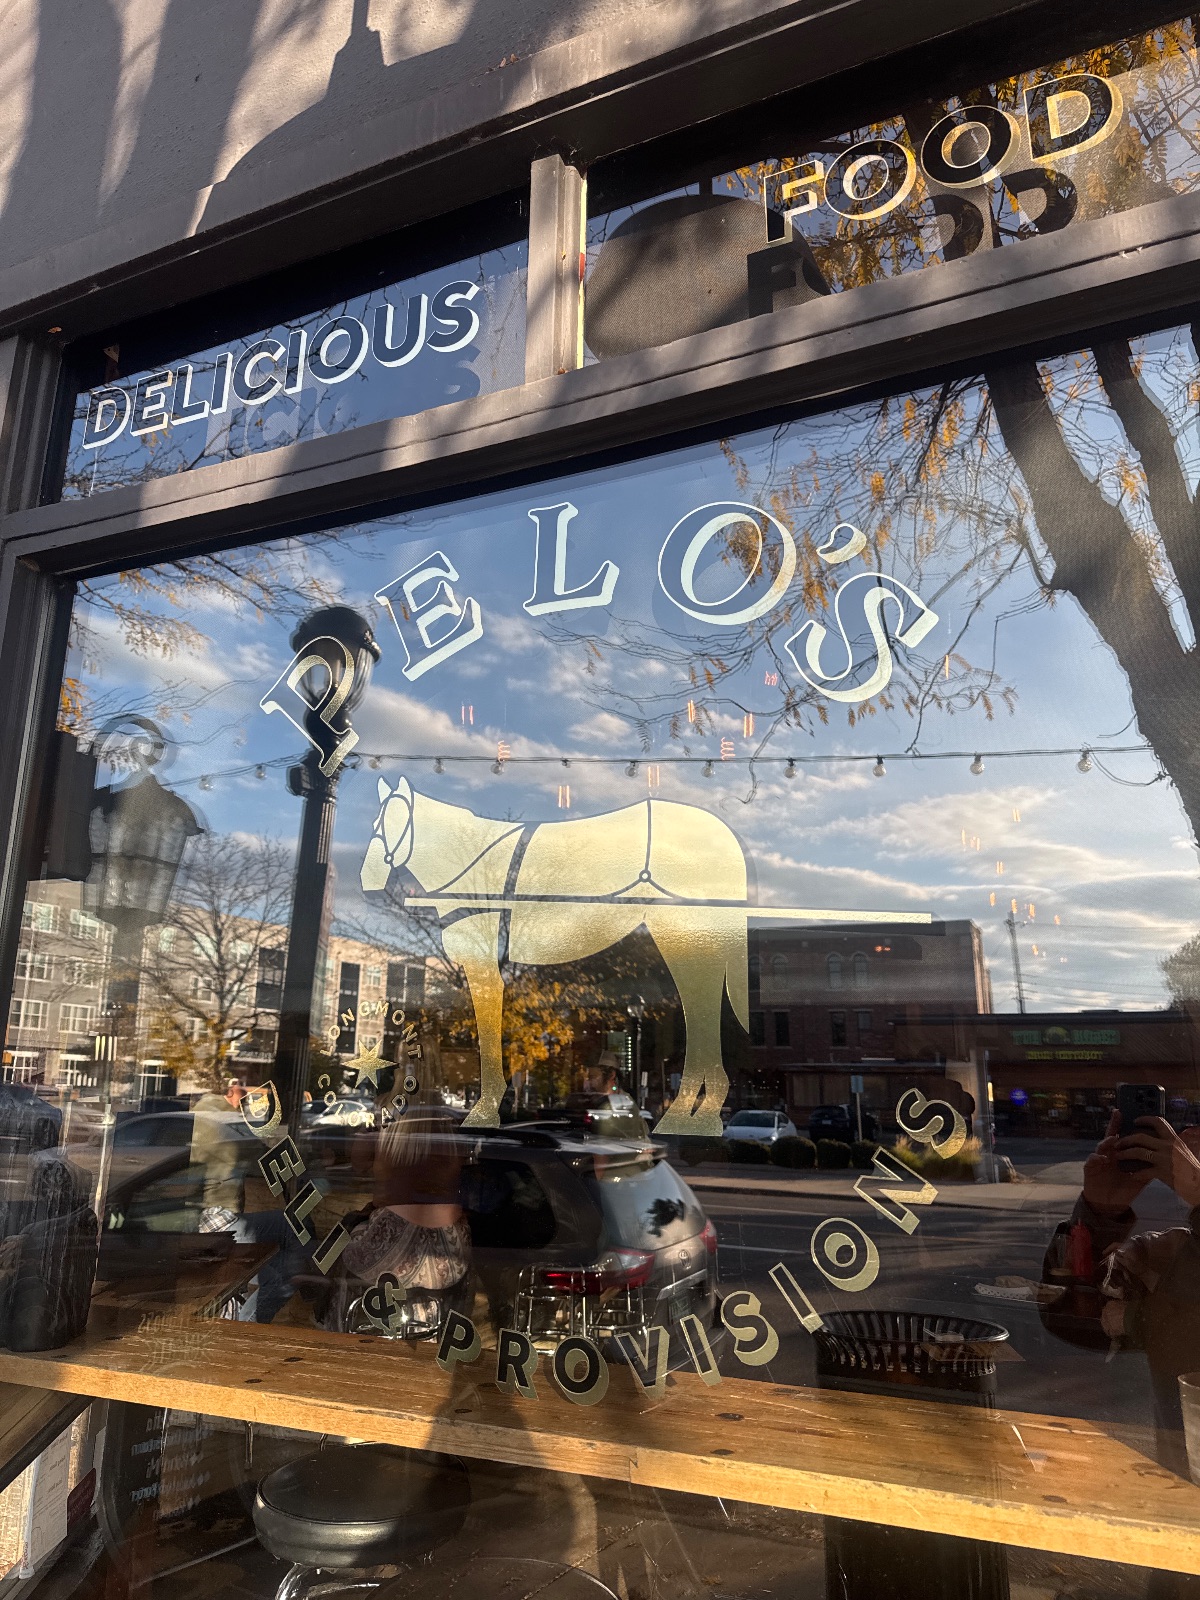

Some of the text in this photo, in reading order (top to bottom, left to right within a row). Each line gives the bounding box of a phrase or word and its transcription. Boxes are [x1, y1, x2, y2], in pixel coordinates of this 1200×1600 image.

[763, 73, 1123, 246] FOOD
[82, 280, 482, 450] DELICIOUS
[259, 500, 940, 778] PELO'S
[318, 1073, 419, 1128] COLORADO
[319, 1000, 424, 1061] LONGMONT
[240, 1080, 968, 1407] DELI & PROVISIONS
